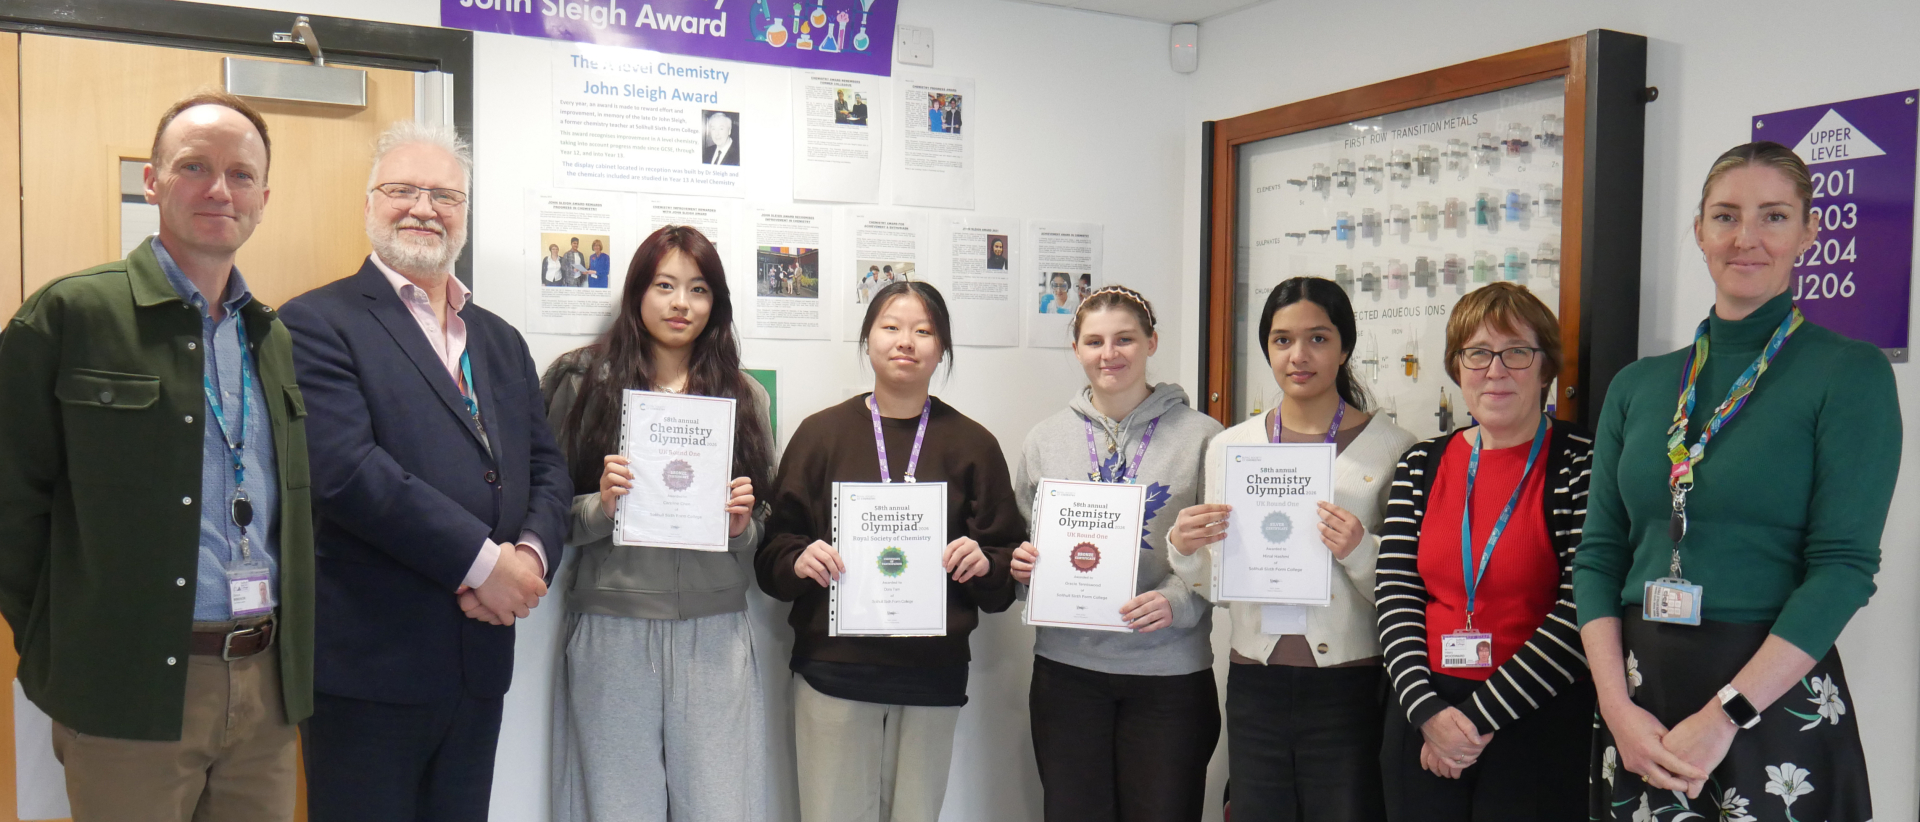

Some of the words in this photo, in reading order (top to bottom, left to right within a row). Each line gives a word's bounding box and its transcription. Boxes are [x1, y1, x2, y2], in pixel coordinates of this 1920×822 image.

[542, 0, 627, 29] Sleigh
[635, 4, 727, 37] Award
[570, 54, 598, 70] The
[657, 63, 730, 83] Chemistry
[584, 81, 618, 96] John
[624, 84, 666, 102] Sleigh
[672, 88, 718, 104] Award
[1344, 136, 1366, 149] FIRST
[1370, 132, 1387, 144] ROW
[1391, 121, 1442, 140] TRANSITION
[1444, 114, 1478, 130] METALS
[1810, 128, 1851, 144] UPPER
[1812, 144, 1849, 160] LEVEL
[1257, 184, 1280, 194] ELEMENTS
[1811, 169, 1854, 198] 201
[1809, 203, 1857, 231] 203
[1256, 238, 1280, 247] SULPHATES
[1792, 272, 1856, 300] J206
[1354, 310, 1378, 321] ECTED
[1382, 306, 1420, 319] AQUEOUS
[1425, 305, 1446, 316] IONS
[650, 423, 712, 438] Chemistry
[650, 433, 706, 447] Olympiad
[1247, 474, 1311, 487] Chemistry
[1247, 485, 1304, 497] Olympiad
[861, 512, 923, 523] Chemistry
[1060, 508, 1121, 522] Chemistry
[861, 522, 918, 534] Olympiad
[1059, 518, 1114, 530] Olympiad
